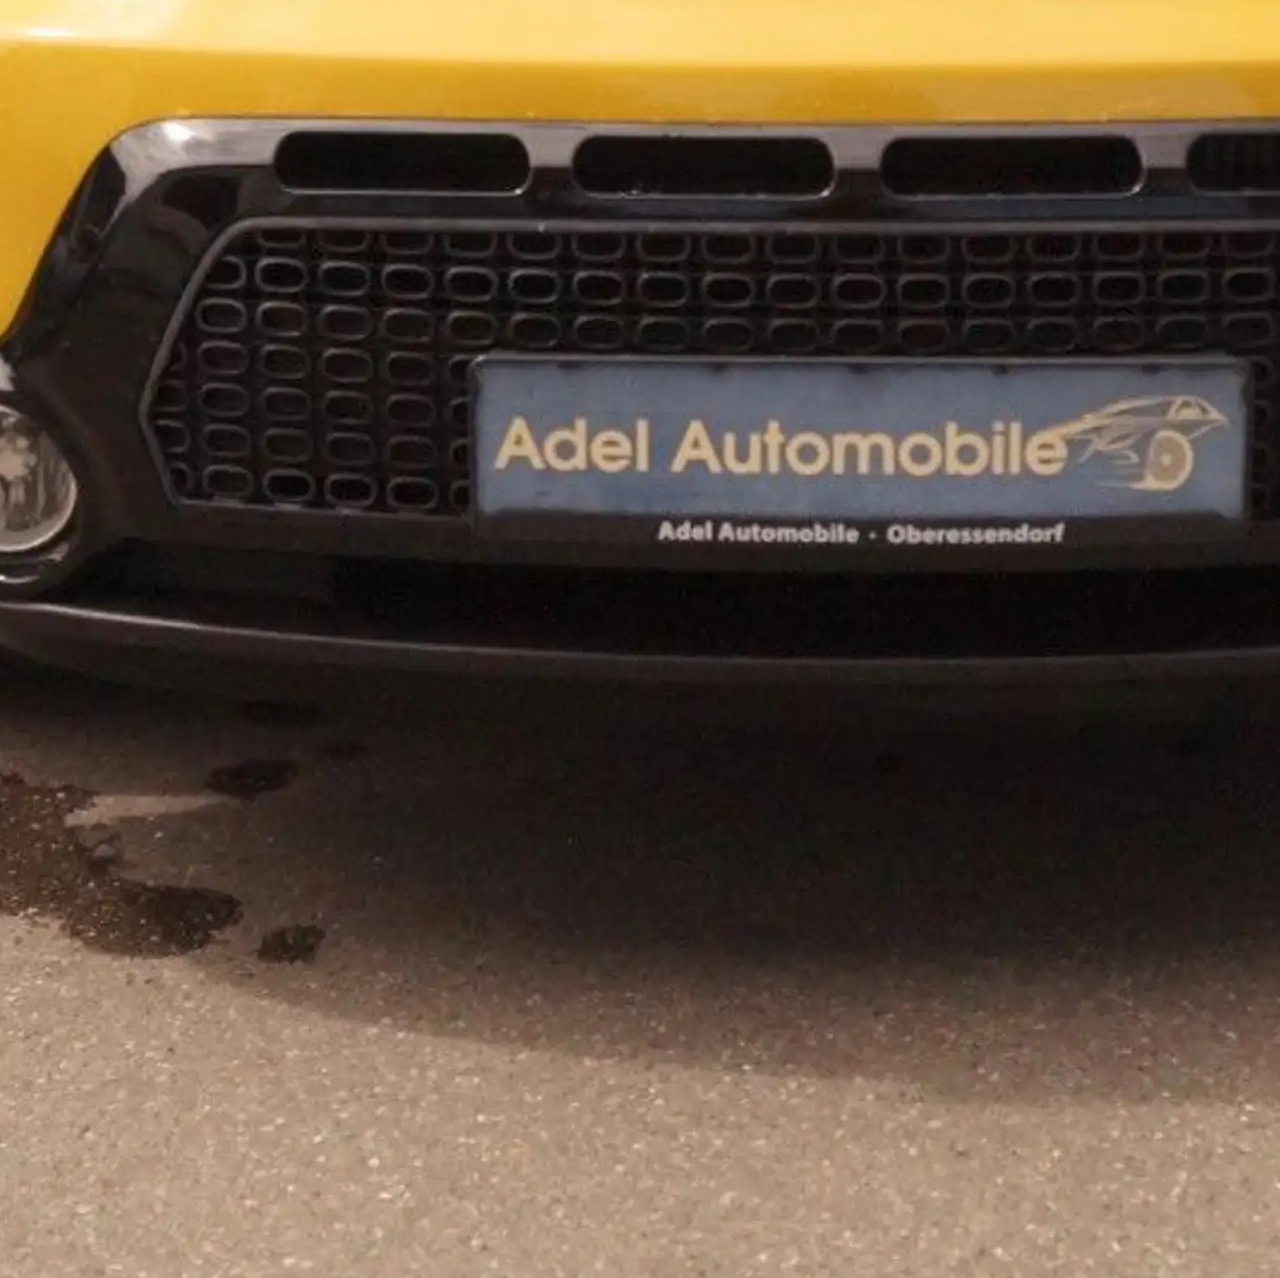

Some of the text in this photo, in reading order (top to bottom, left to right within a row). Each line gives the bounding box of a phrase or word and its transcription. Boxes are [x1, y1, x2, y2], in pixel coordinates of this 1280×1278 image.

[493, 415, 1068, 476] Adel Automobile
[657, 520, 1066, 544] Adel Automobile Oberessendorf
